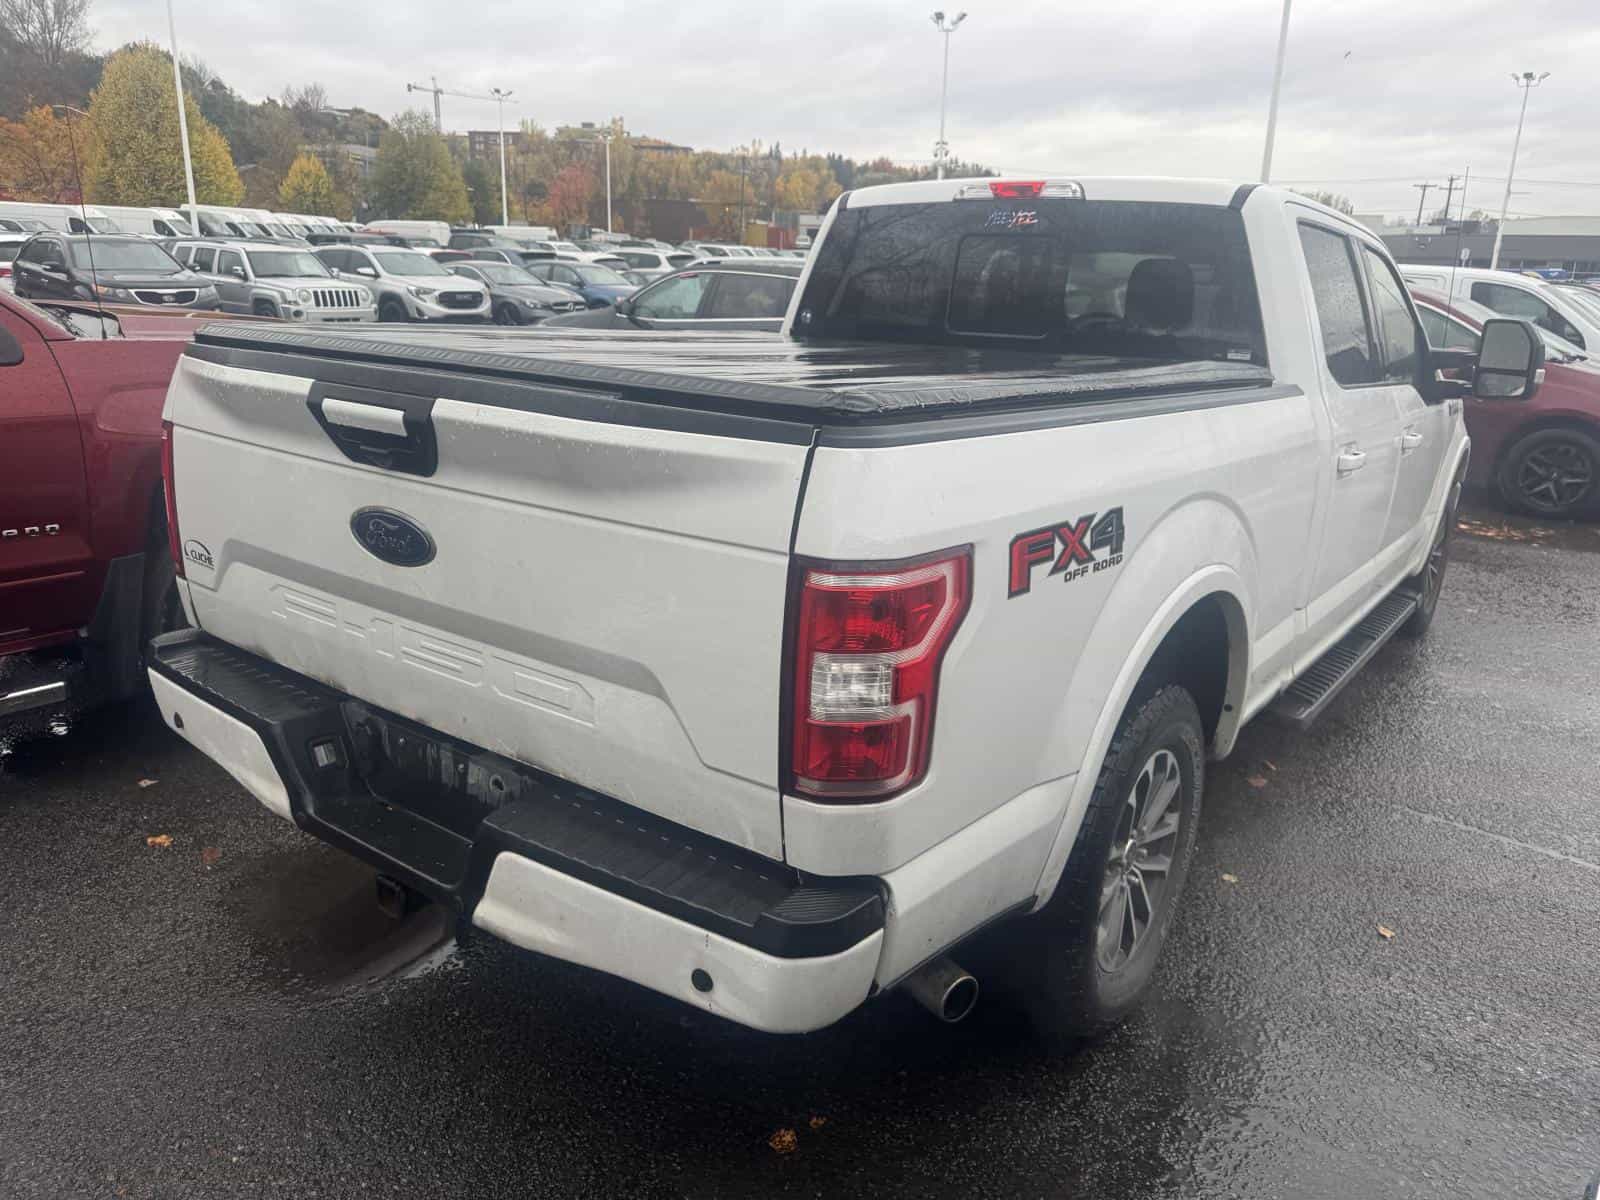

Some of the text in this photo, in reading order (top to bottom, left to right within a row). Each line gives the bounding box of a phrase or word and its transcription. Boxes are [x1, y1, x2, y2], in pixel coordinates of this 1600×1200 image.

[1007, 506, 1125, 600] FX4
[1063, 554, 1123, 583] OFF ROAD
[269, 583, 597, 729] F-150
